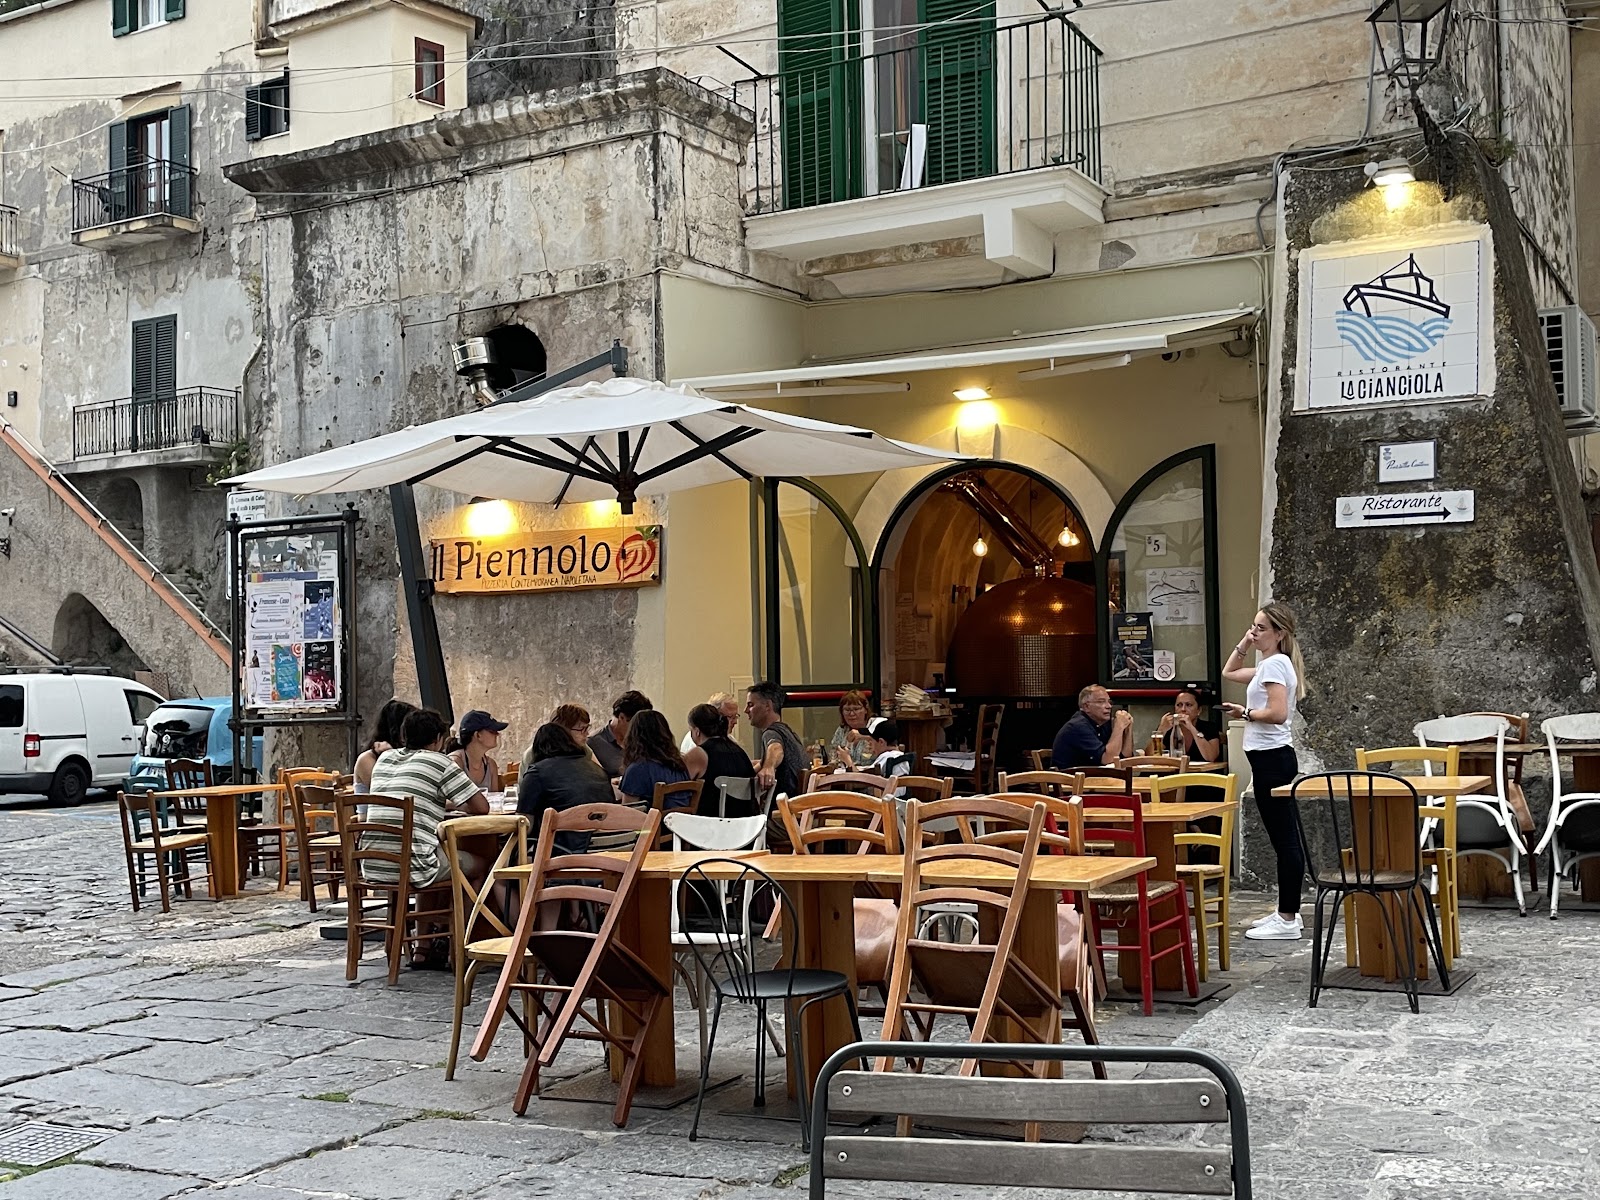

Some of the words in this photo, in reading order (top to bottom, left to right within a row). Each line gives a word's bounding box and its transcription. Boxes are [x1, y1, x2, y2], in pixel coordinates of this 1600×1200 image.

[1337, 361, 1447, 377] RISTORANTE
[1361, 494, 1443, 512] Ristorante
[1153, 539, 1161, 553] 5
[432, 543, 446, 583] Il
[454, 535, 612, 581] Piennolo
[481, 577, 509, 590] PIZZERIA
[560, 574, 598, 586] NAPOLETANA
